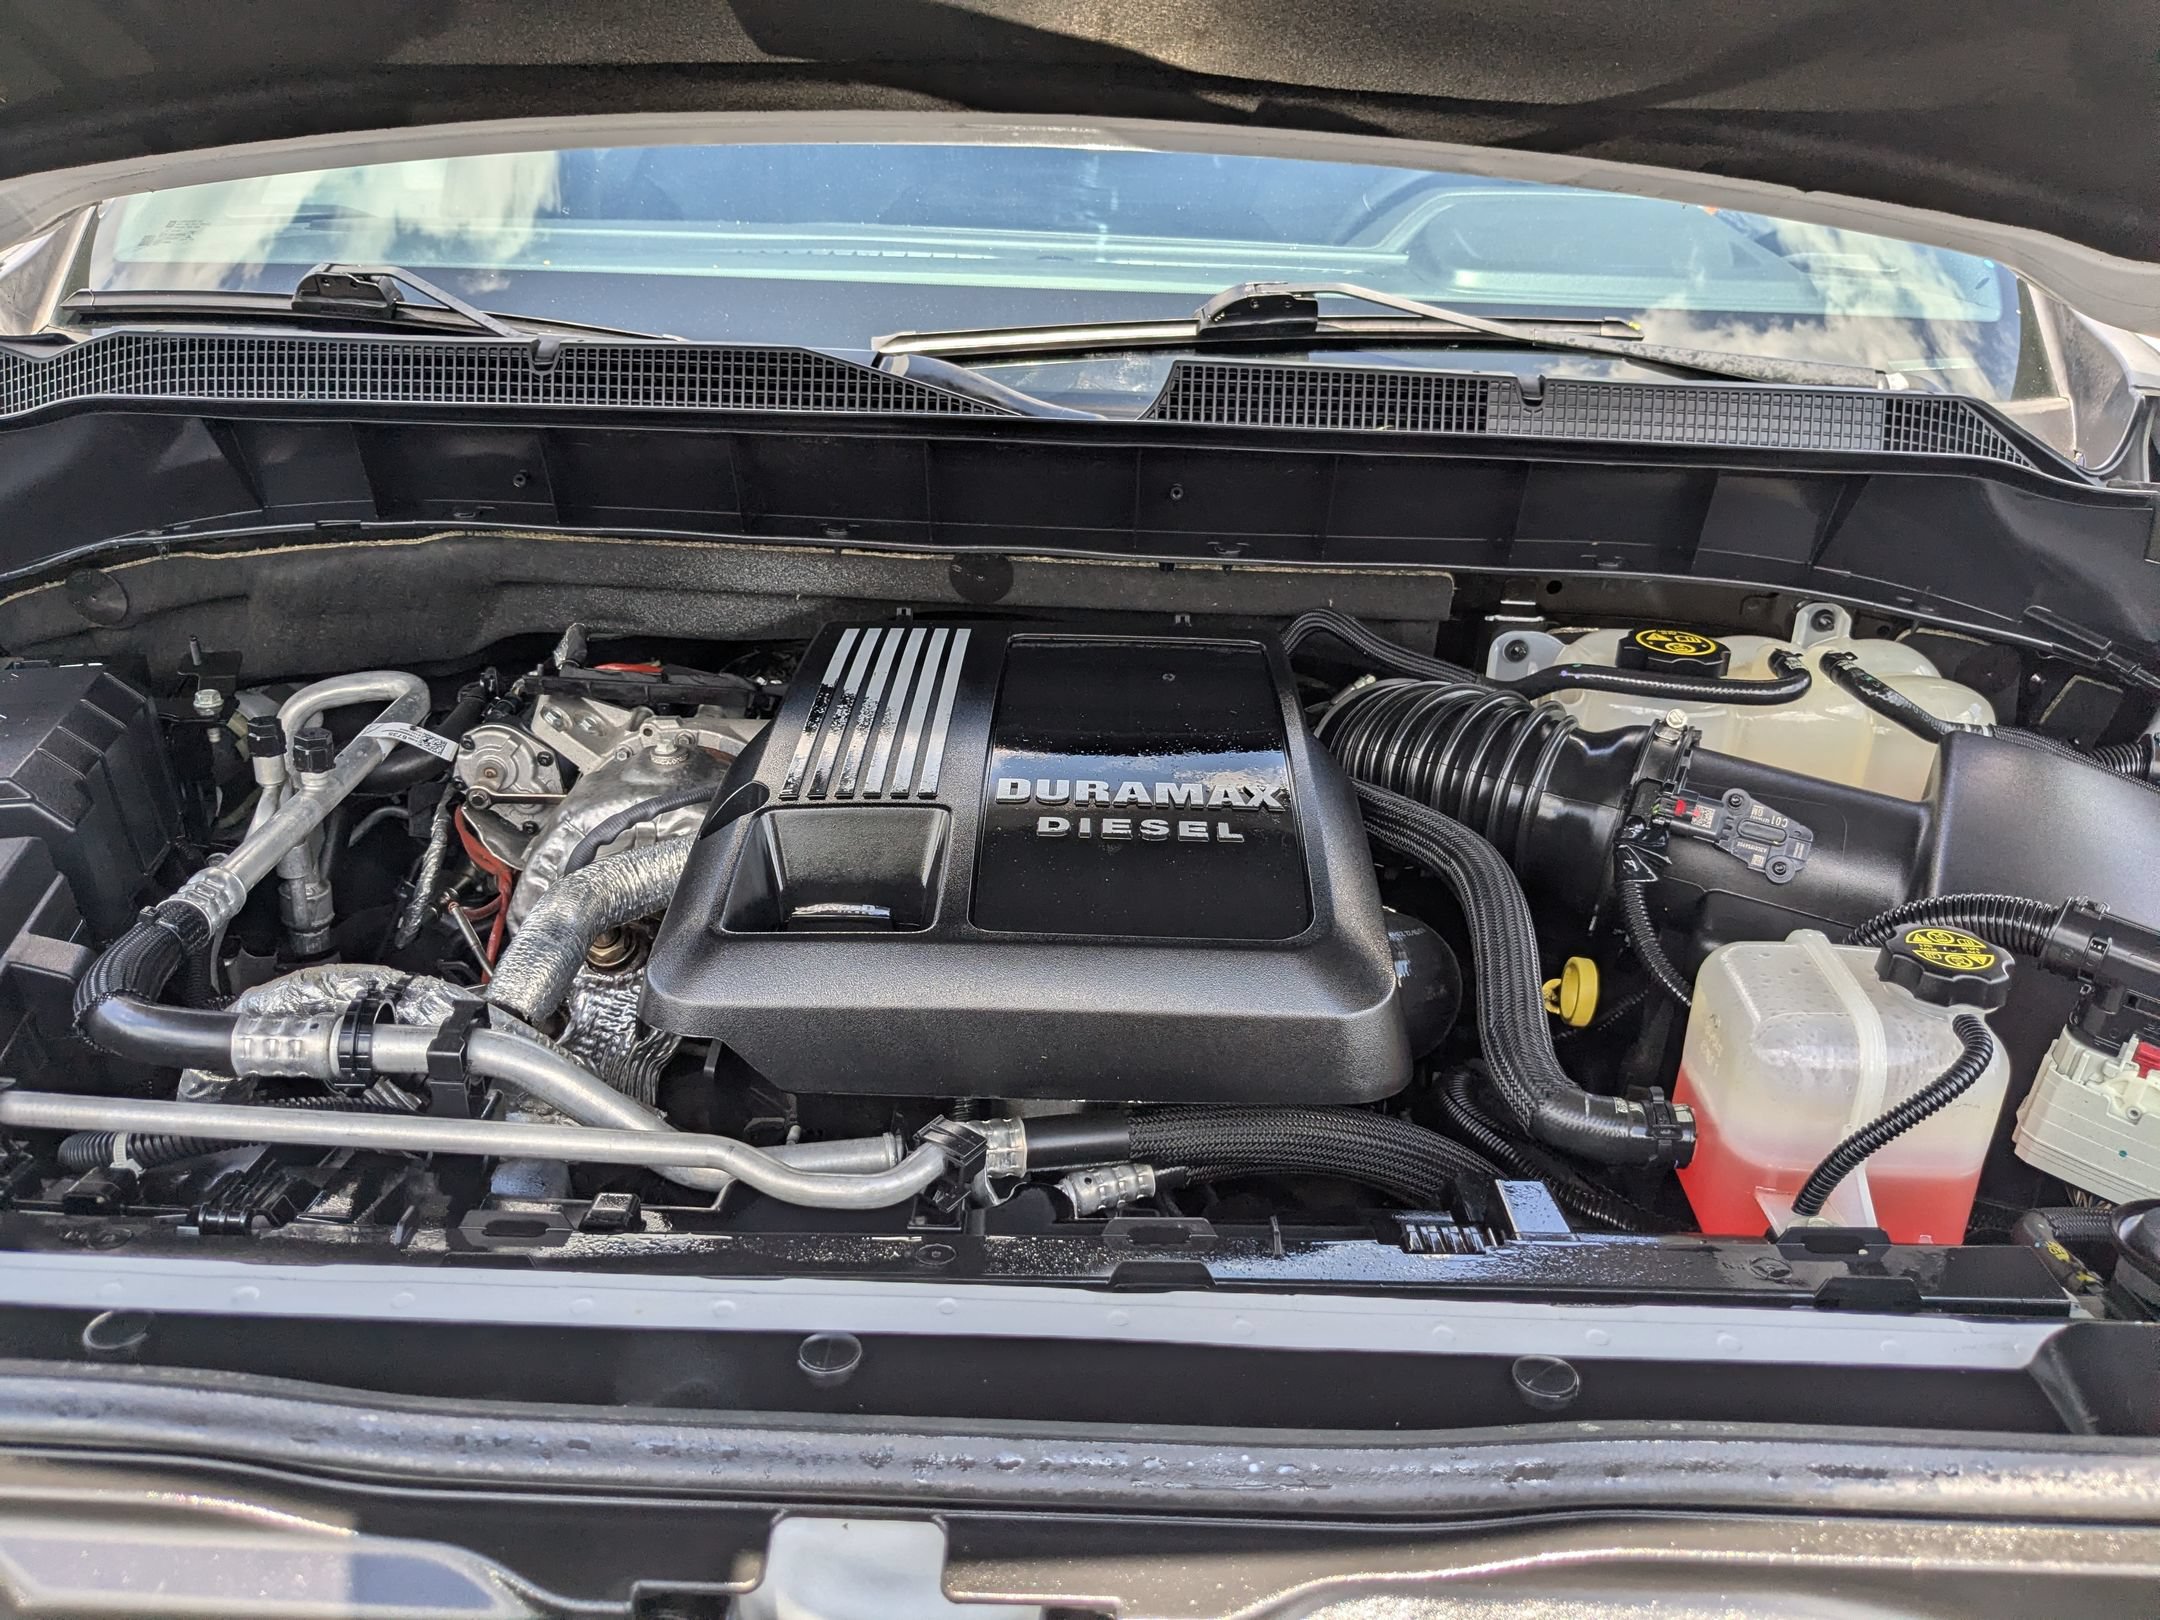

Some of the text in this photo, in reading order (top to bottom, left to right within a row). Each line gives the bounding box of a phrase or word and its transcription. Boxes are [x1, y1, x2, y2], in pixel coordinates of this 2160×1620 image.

[996, 777, 1286, 812] DURAMAX
[1036, 816, 1245, 842] DIESEL
[1770, 815, 1788, 828] C01
